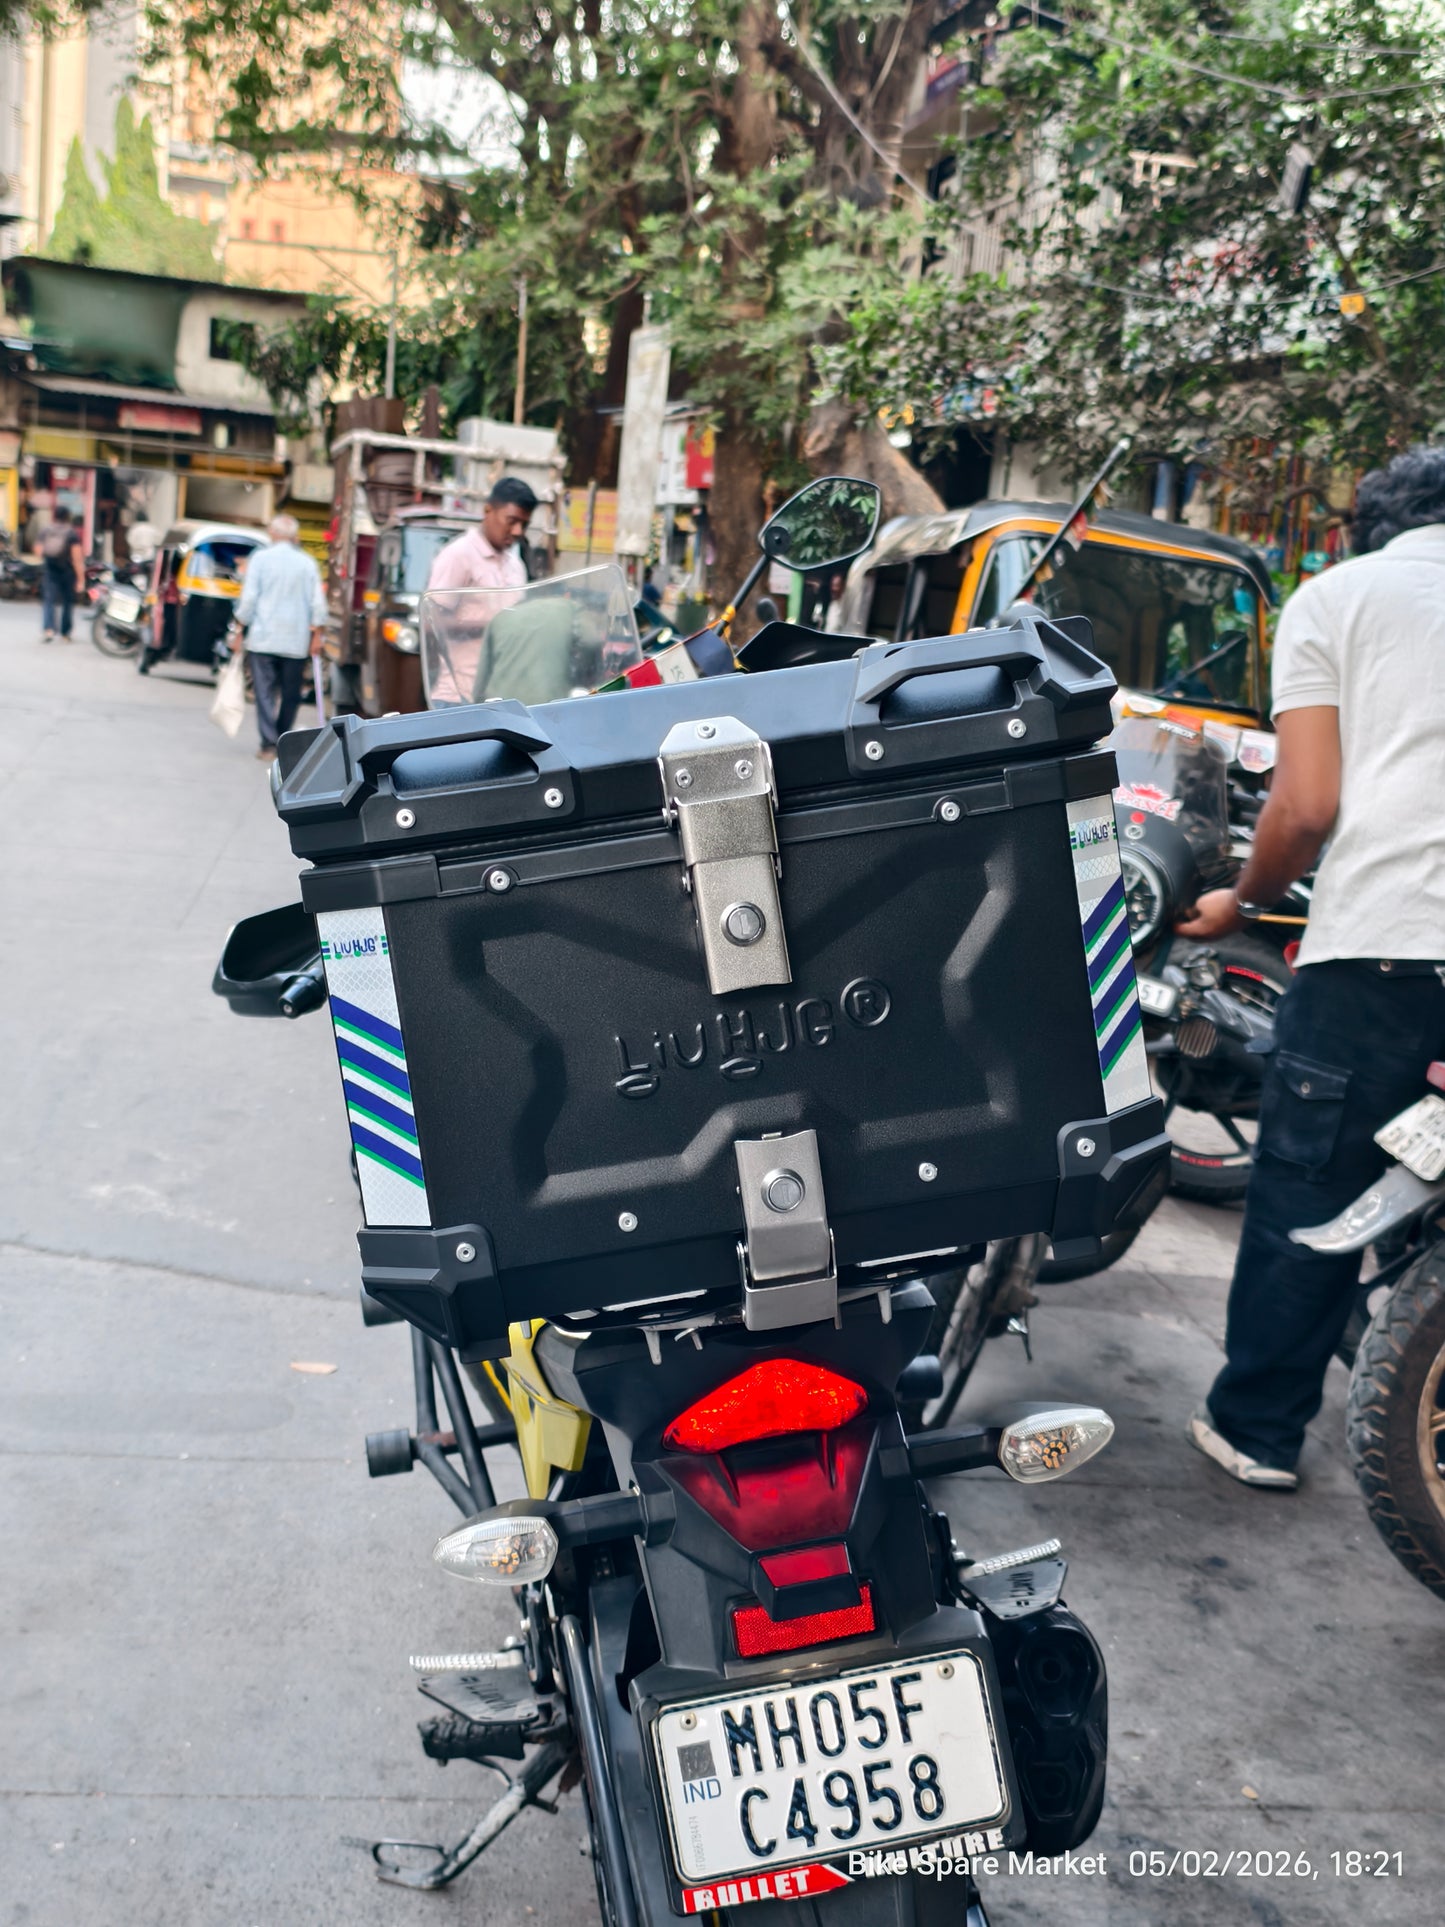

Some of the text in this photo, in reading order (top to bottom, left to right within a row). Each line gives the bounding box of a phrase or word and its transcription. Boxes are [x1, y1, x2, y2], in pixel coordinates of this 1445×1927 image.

[720, 1671, 923, 1777] MH05F
[682, 1778, 723, 1804] IND
[740, 1754, 946, 1857] C4958
[693, 1869, 810, 1912] BULLET
